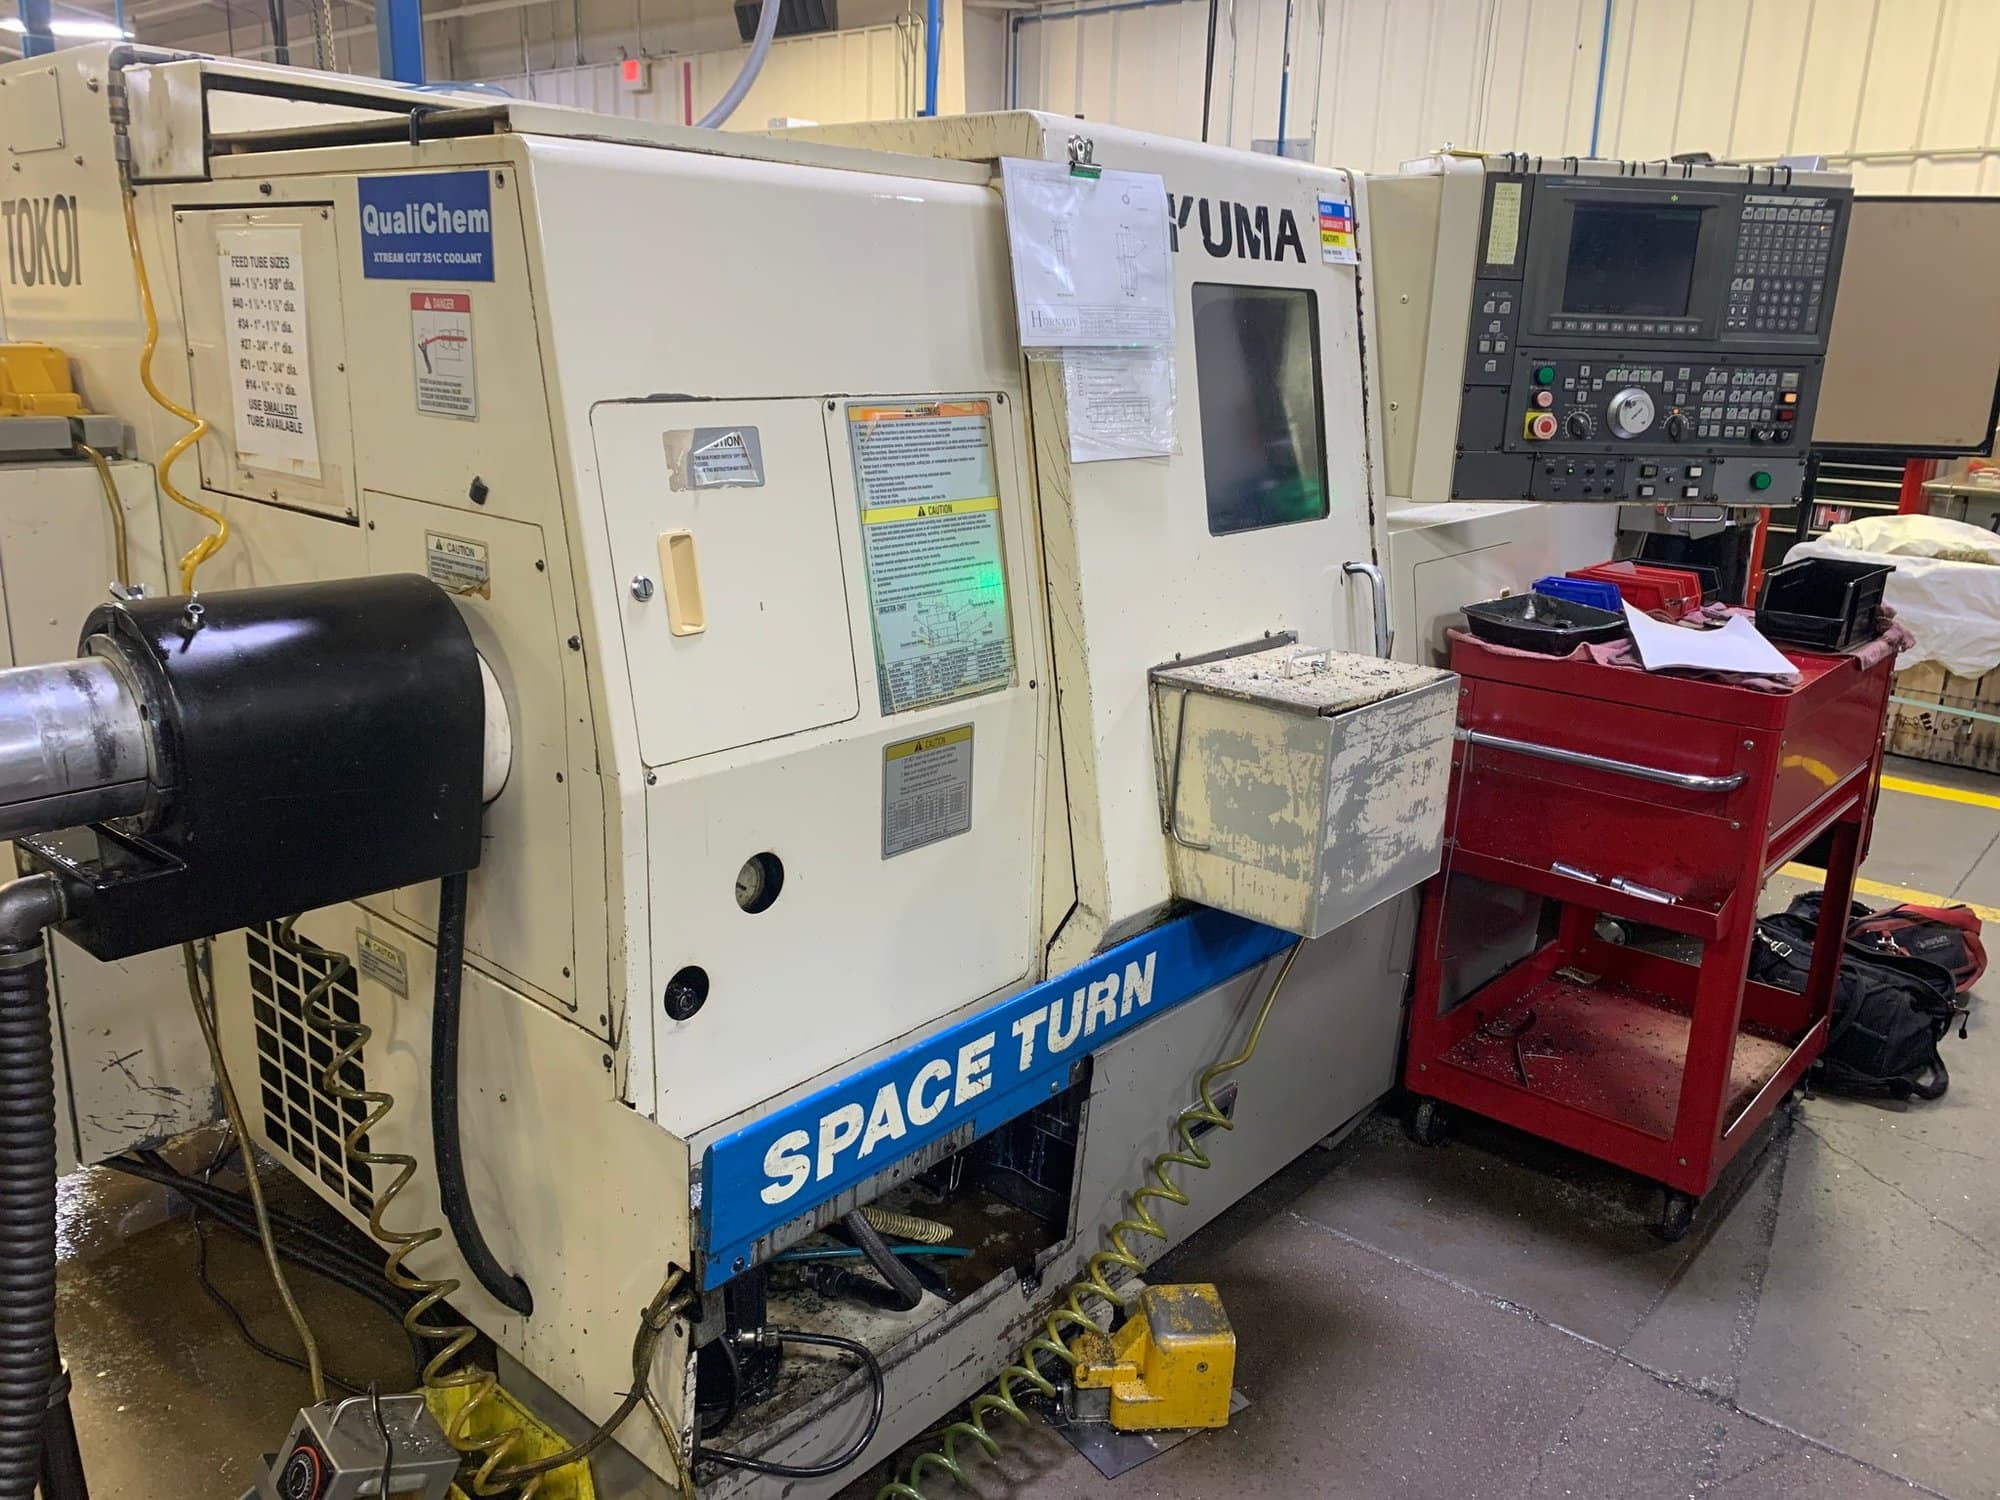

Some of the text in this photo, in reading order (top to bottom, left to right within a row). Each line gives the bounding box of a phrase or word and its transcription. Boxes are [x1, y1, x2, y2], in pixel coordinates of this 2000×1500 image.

[362, 202, 490, 236] QualiChem
[231, 255, 290, 269] FEED TUBE SIZES
[373, 252, 483, 264] XTREAM CUT 251C COOLANT
[248, 399, 298, 416] USE SMALLEST
[246, 414, 303, 435] TUBE AVAILABLE
[928, 504, 953, 516] CAUTION
[446, 542, 476, 558] CAUTION
[760, 951, 1158, 1206] SPACE TURN
